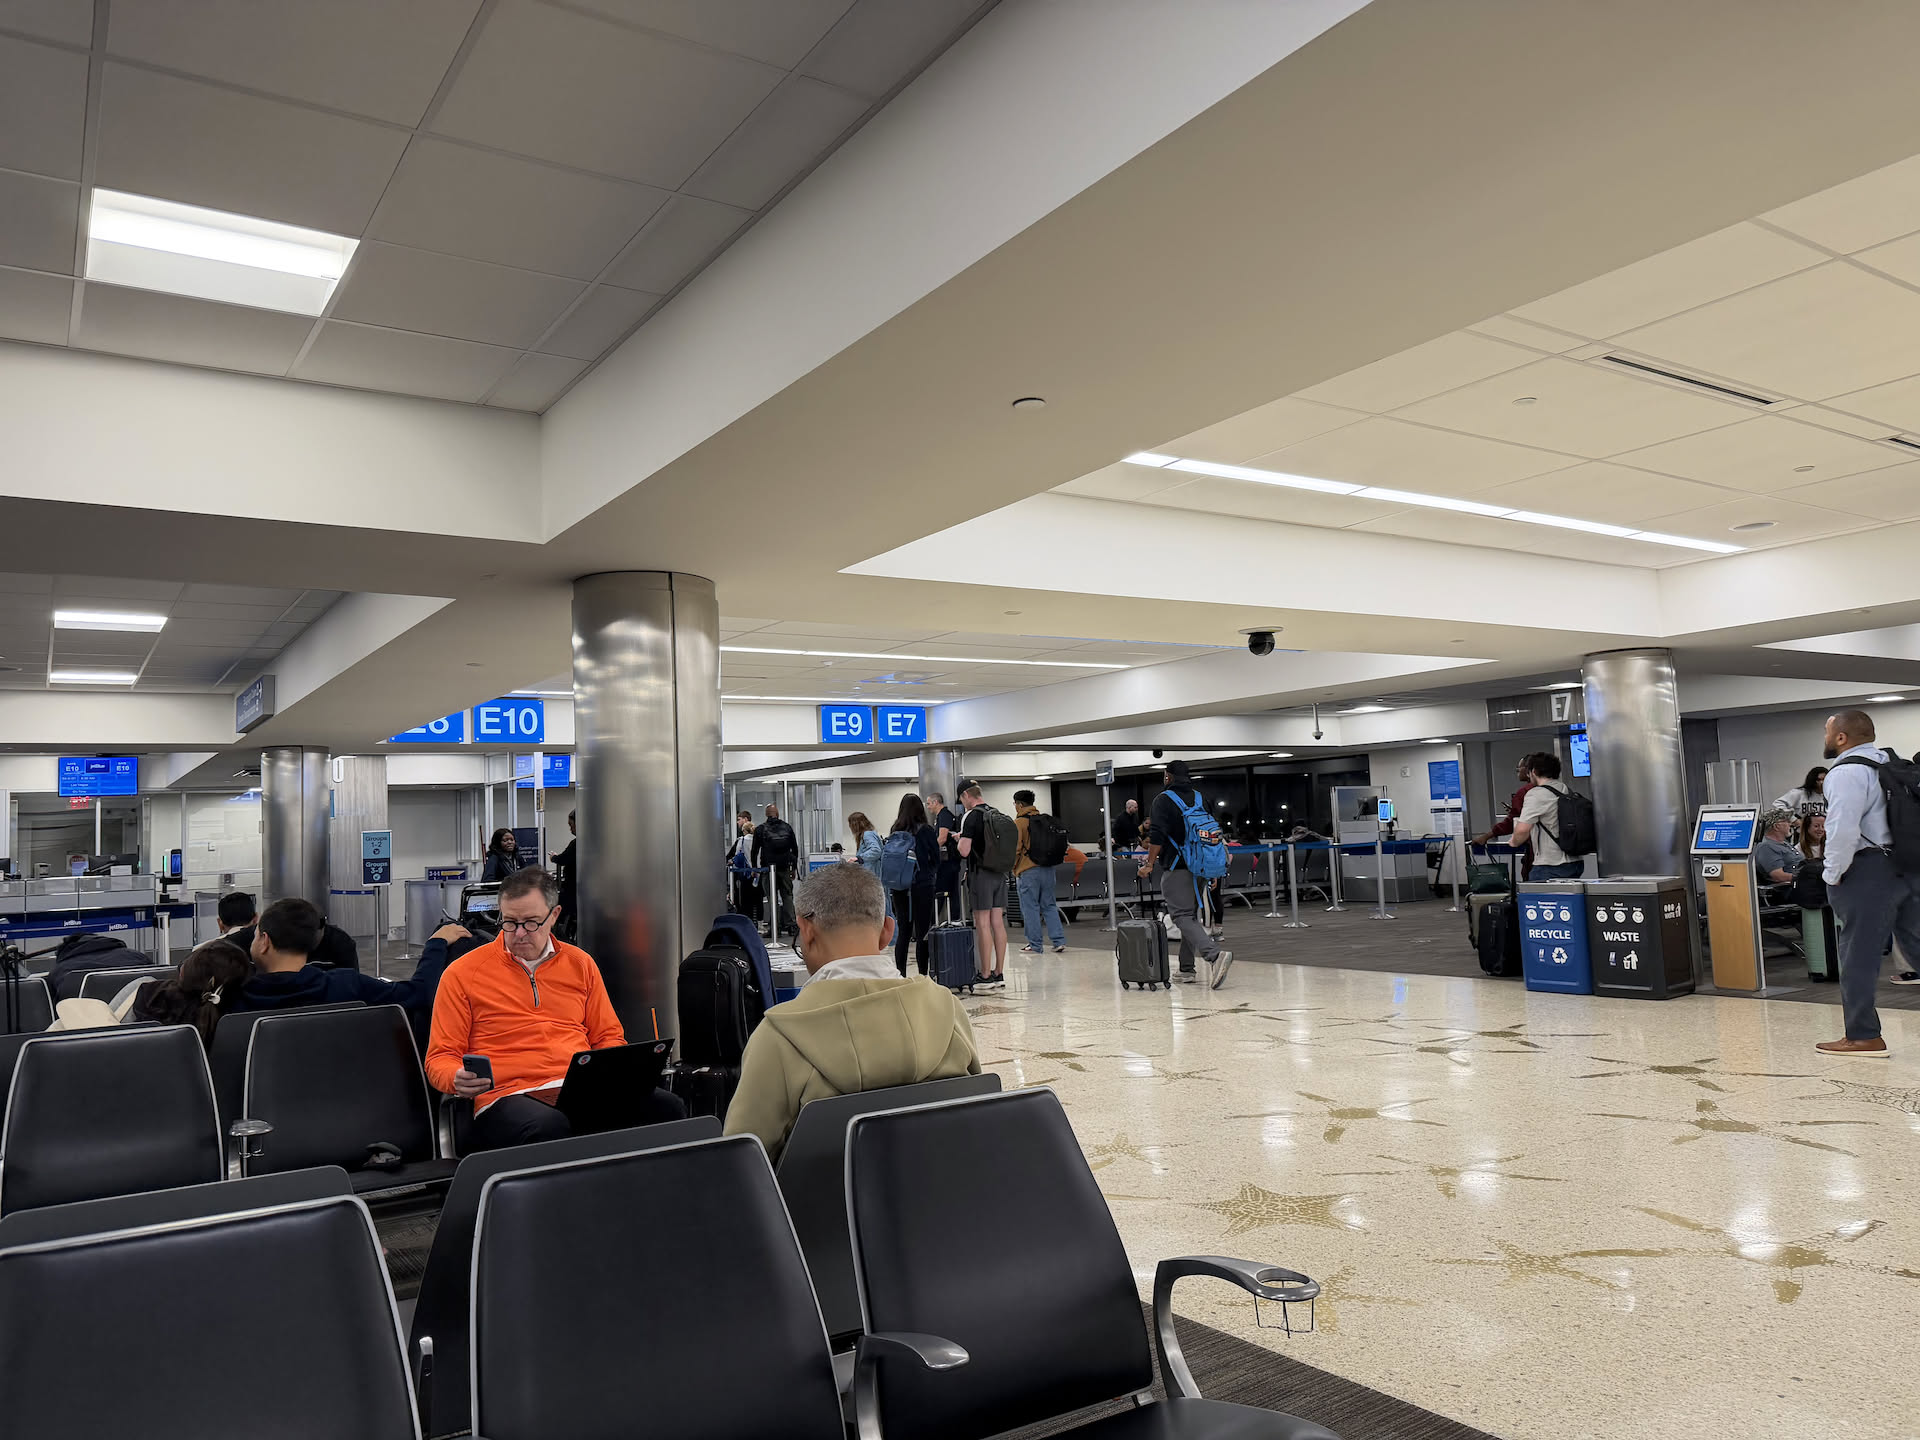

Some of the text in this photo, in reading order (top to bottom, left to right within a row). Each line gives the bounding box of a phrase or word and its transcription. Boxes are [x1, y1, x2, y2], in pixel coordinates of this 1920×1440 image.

[1550, 692, 1571, 721] E7
[479, 707, 538, 735] E10
[831, 712, 863, 736] E9
[887, 713, 917, 736] E7
[63, 919, 82, 927] jetBlue
[108, 923, 128, 932] jetBlue
[1528, 929, 1571, 940] RECYCLE
[1603, 931, 1640, 942] WASTE
